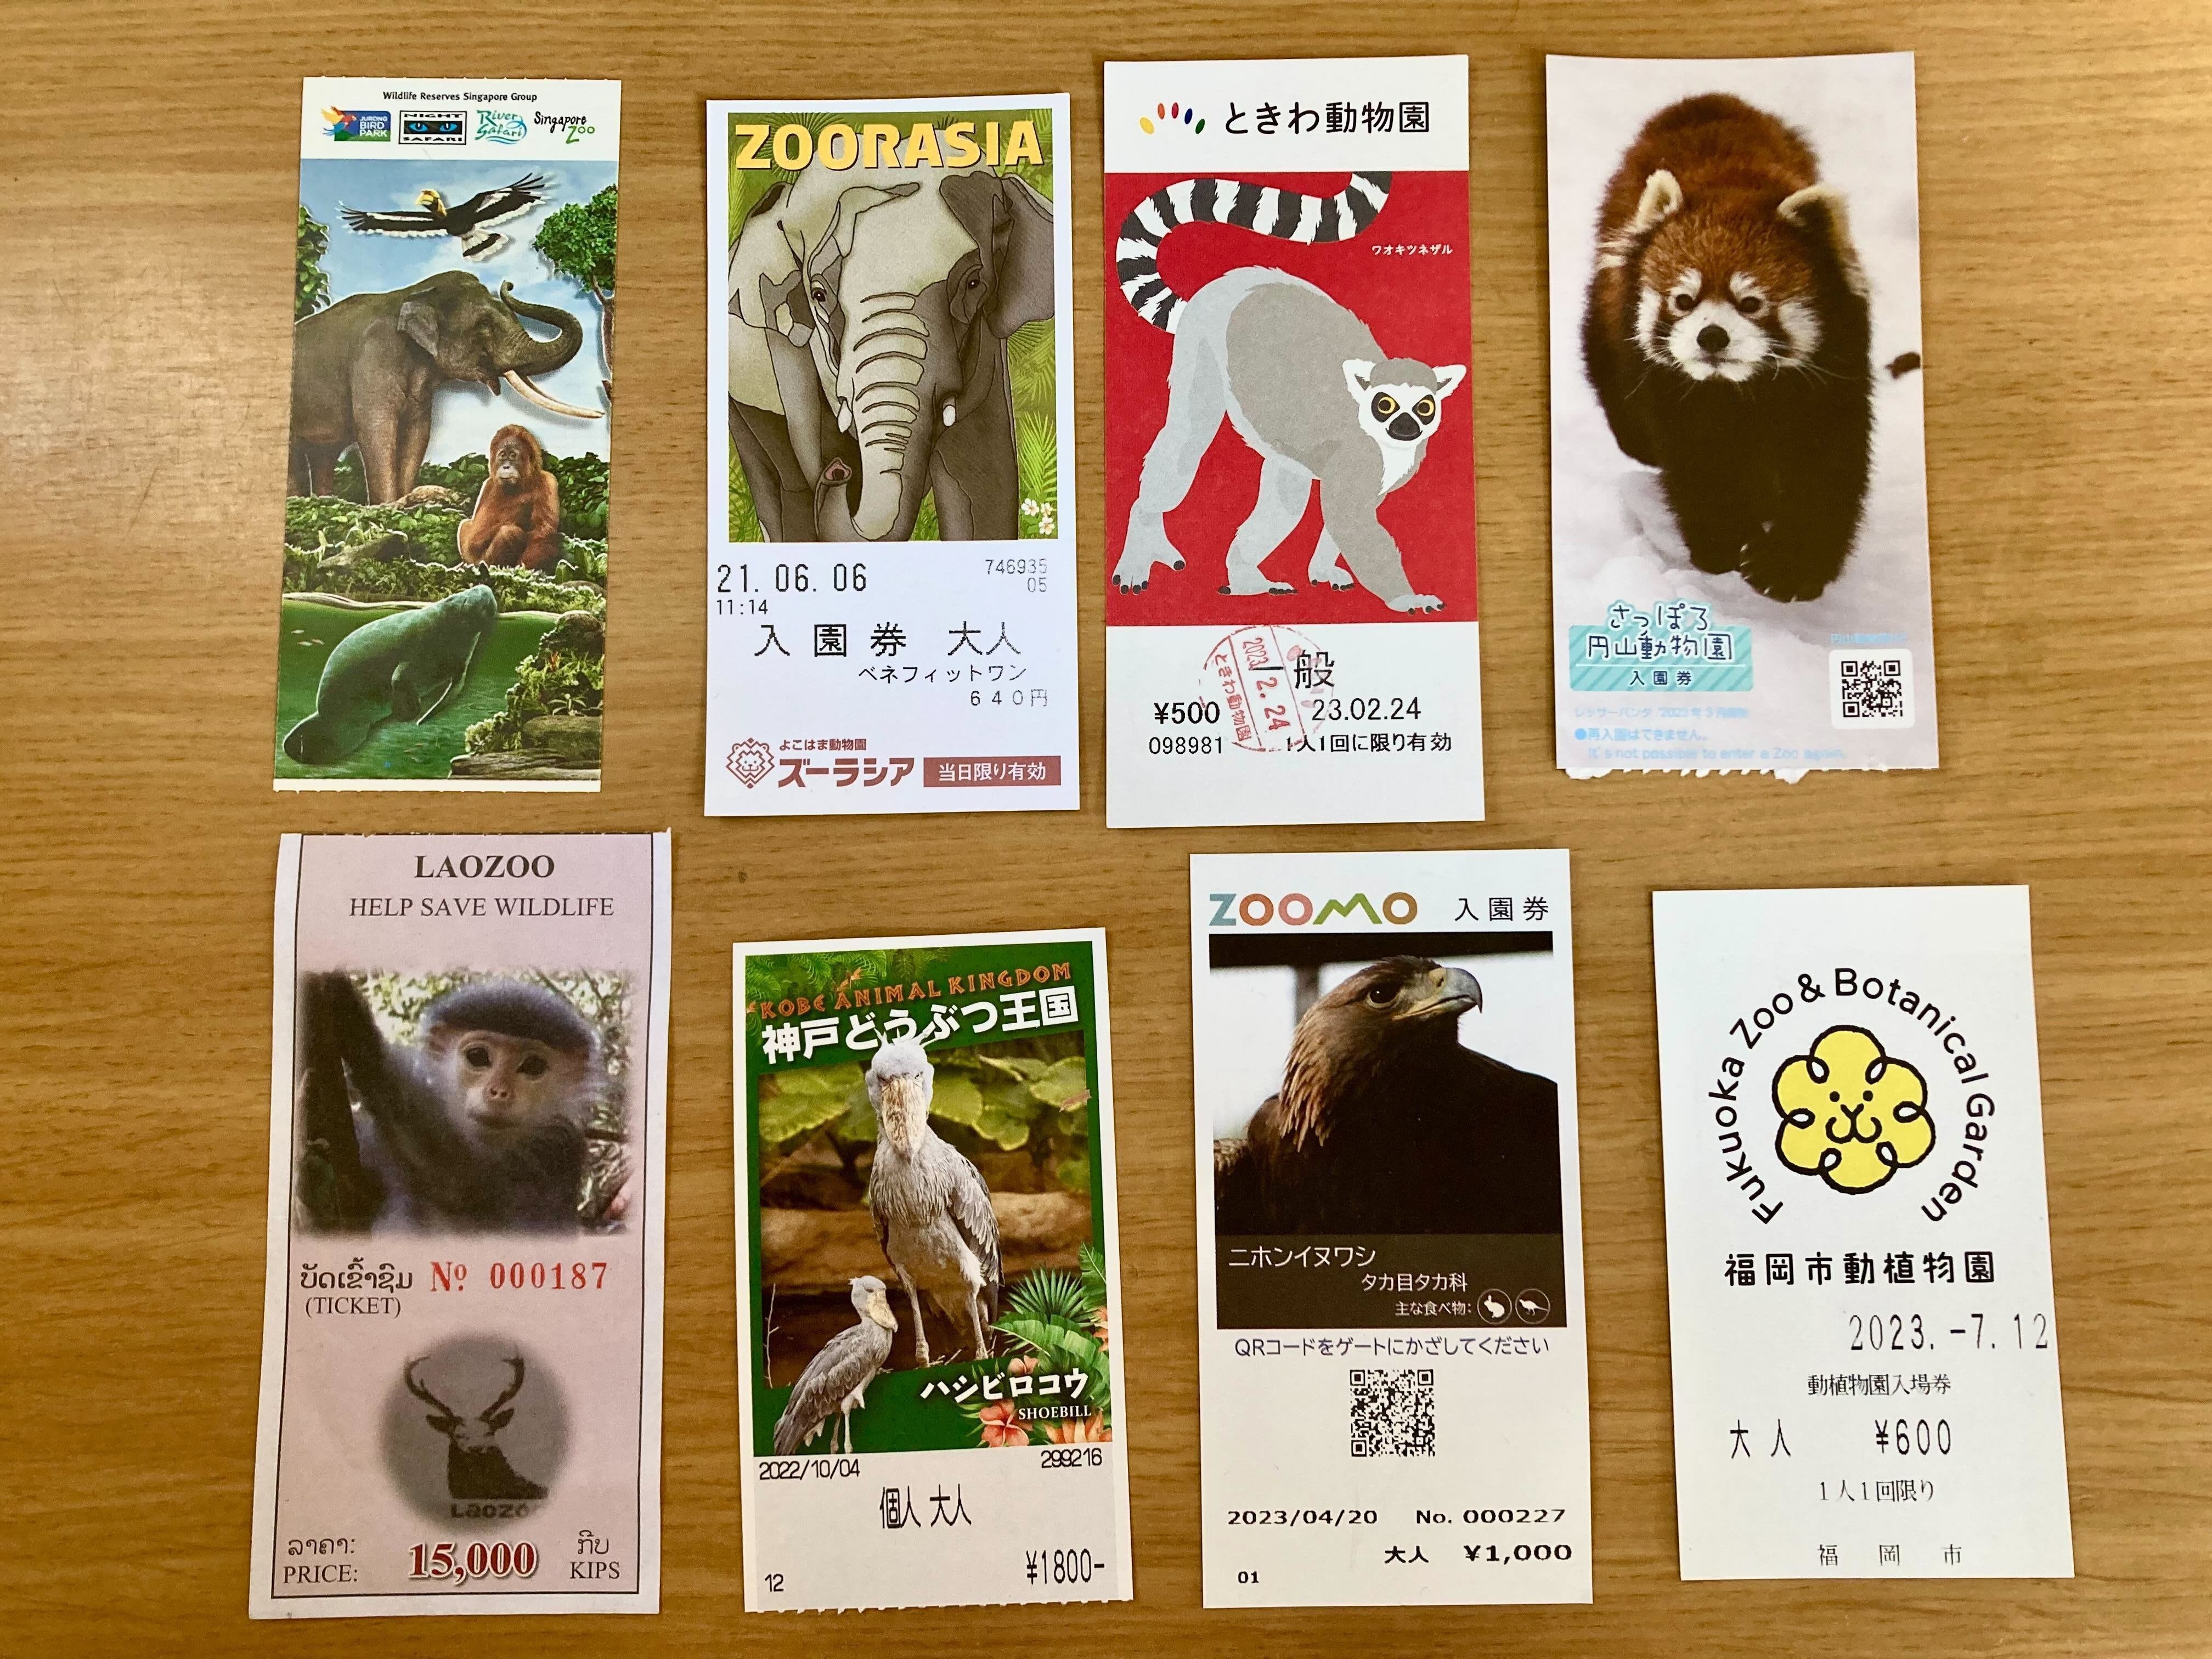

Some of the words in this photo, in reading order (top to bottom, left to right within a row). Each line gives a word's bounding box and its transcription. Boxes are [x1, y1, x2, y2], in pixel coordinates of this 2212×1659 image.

[383, 92, 417, 100] Wildlife
[464, 92, 507, 103] Singapore
[511, 93, 537, 102] Group
[476, 110, 517, 126] River
[534, 111, 586, 133] Singapore
[1225, 101, 1429, 134] ときわ動物園
[475, 123, 522, 140] Safari
[566, 126, 595, 144] Zoo
[736, 121, 1043, 170] ZOORASIA
[1372, 245, 1453, 255] ワオキツネザル
[986, 558, 1047, 575] 746935
[1028, 577, 1047, 592] 05
[717, 600, 768, 614] 11:14
[1610, 603, 1711, 630] さっぽろ
[755, 622, 906, 657] 入園券
[948, 621, 1021, 656] 大人
[1588, 630, 1732, 660] 円山動物園
[858, 665, 1026, 682] ベネフィットワン
[1629, 670, 1691, 686] 入園券
[1154, 702, 1220, 724] ¥500
[1312, 697, 1421, 720] 23.02.24
[779, 738, 866, 751] よこはま動物園
[1149, 737, 1222, 754] 098981
[778, 758, 915, 787] ズーラシア
[939, 763, 1046, 781] 当日限り有効
[415, 855, 555, 878] LAOZOO
[350, 898, 413, 917] HELP
[421, 898, 486, 916] SAVE
[494, 898, 614, 916] WILDLIFE
[1209, 892, 1417, 927] ZOOMO
[1454, 896, 1549, 922] 入園券
[761, 994, 826, 1019] KOBE
[834, 977, 942, 1010] ANIMAL
[949, 962, 1071, 995] KINGDOM
[1798, 973, 1826, 1003] &
[761, 985, 1079, 1064] 神戸どうぶつ王国
[1729, 992, 1793, 1049] Zoo
[1835, 967, 1989, 1084] Botanical
[1708, 1056, 1784, 1224] Fukuoka
[1921, 1092, 1995, 1222] Garden
[1228, 1245, 1376, 1268] ニホンイヌワシ
[490, 1262, 608, 1290] 000187
[1724, 1251, 1995, 1286] 福岡市動植物園
[1361, 1273, 1468, 1293] タカ目タカ科
[305, 1296, 402, 1318] (TICKET)
[1234, 1338, 1549, 1357] QRコードをゲートにかざしてください
[921, 1368, 1089, 1402] ハシビロコウ
[1808, 1373, 1951, 1396] 動植物園入場券
[1018, 1404, 1092, 1420] SHOEBILL
[1875, 1419, 1951, 1455] ¥600
[759, 1458, 860, 1480] 2022/10/04
[1042, 1448, 1102, 1469] 299216
[1820, 1480, 1935, 1502] 1人1回限り
[880, 1486, 921, 1529] 個人
[930, 1484, 972, 1527] 大人
[1416, 1510, 1452, 1524] No.
[1463, 1509, 1566, 1523] 000227
[1228, 1509, 1378, 1527] 2023/04/20
[409, 1541, 538, 1585] 15,000
[1384, 1545, 1430, 1564] 大人
[1464, 1544, 1572, 1565] ¥1,000
[284, 1565, 358, 1584] PRICE:
[569, 1562, 620, 1579] KIPS
[1238, 1571, 1260, 1584] 01
[765, 1574, 784, 1592] 12
